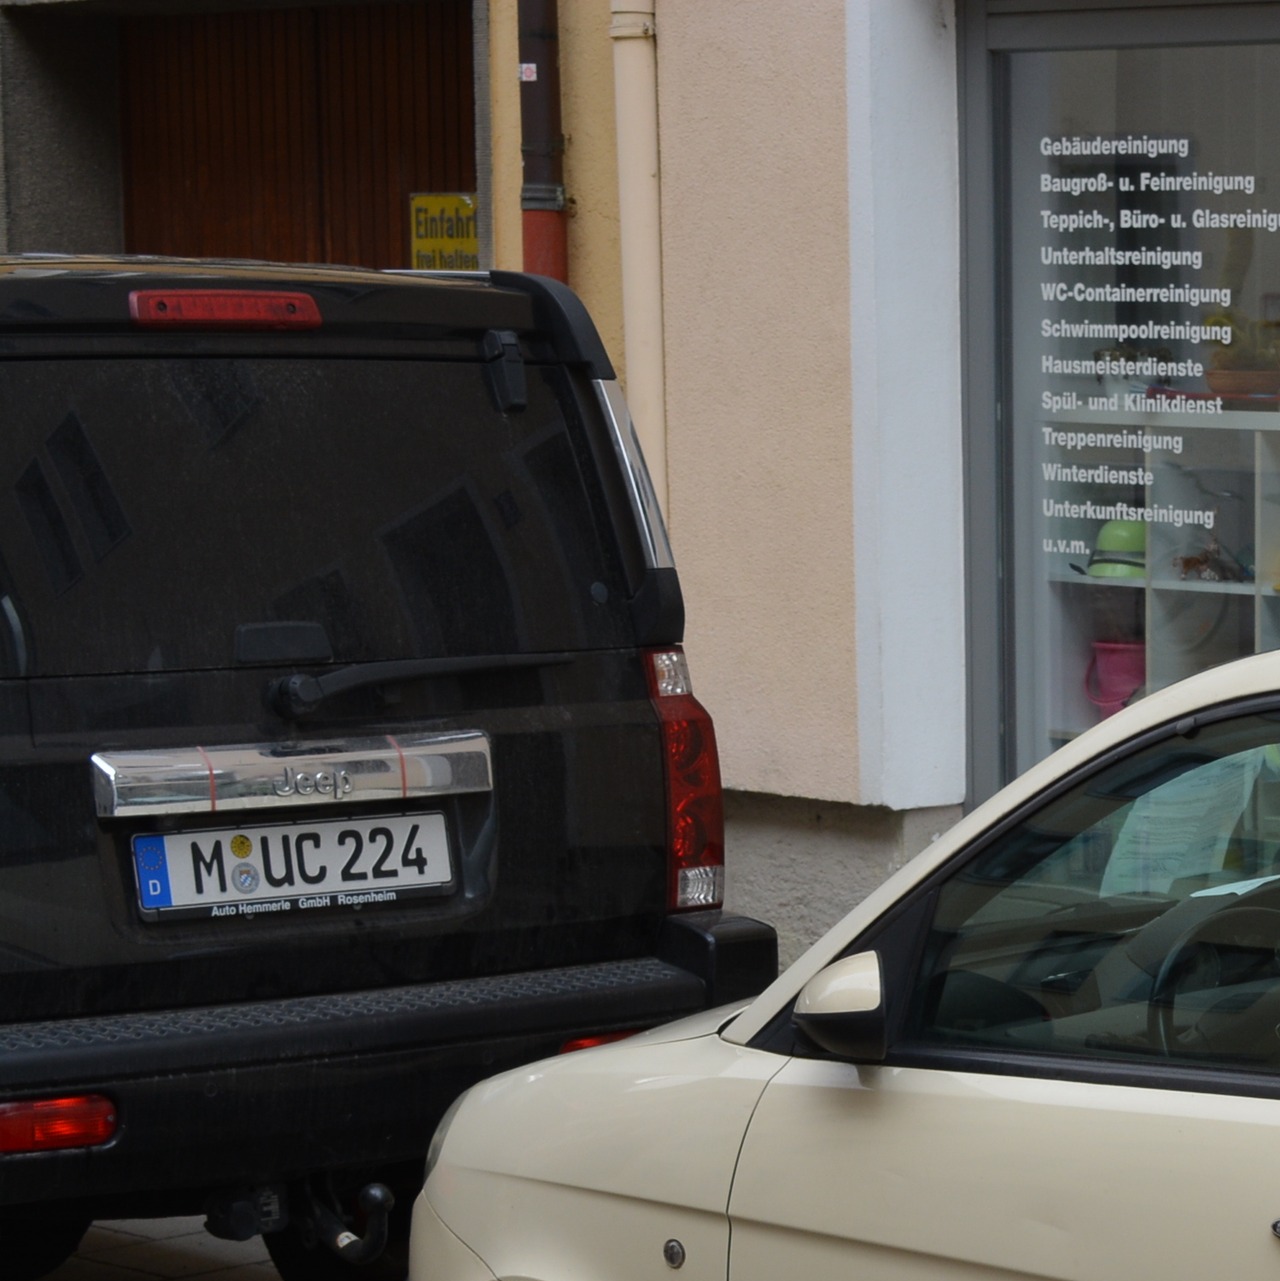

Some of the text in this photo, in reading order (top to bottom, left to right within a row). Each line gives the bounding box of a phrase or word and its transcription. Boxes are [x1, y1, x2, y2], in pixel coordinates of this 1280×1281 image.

[1040, 136, 1189, 158] Gebäudereinigung
[1040, 172, 1255, 194] Baugroß- u. Feinreinigung
[1041, 209, 1115, 233] Teppich-,
[1120, 209, 1166, 229] Büro-
[1171, 213, 1187, 229] u.
[416, 249, 436, 270] frei
[1041, 246, 1203, 269] Unterhaltsreinigung
[1041, 282, 1231, 307] WC-Containerreinigung
[1041, 319, 1232, 344] Schwimmpoolreinigung
[1041, 356, 1203, 377] Hausmeisterdienste
[1041, 392, 1223, 415] Spül- und Klinikdienst
[1042, 427, 1184, 454] Treppenreinigung
[1042, 463, 1154, 486] Winterdienste
[1042, 499, 1215, 529] Unterkunftsreinigung
[1042, 538, 1091, 555] u.v.m.
[272, 767, 354, 800] Jeep
[148, 824, 429, 897] D M UC 224
[211, 890, 397, 918] Auto Hemmerle GmbH Rosenheim
